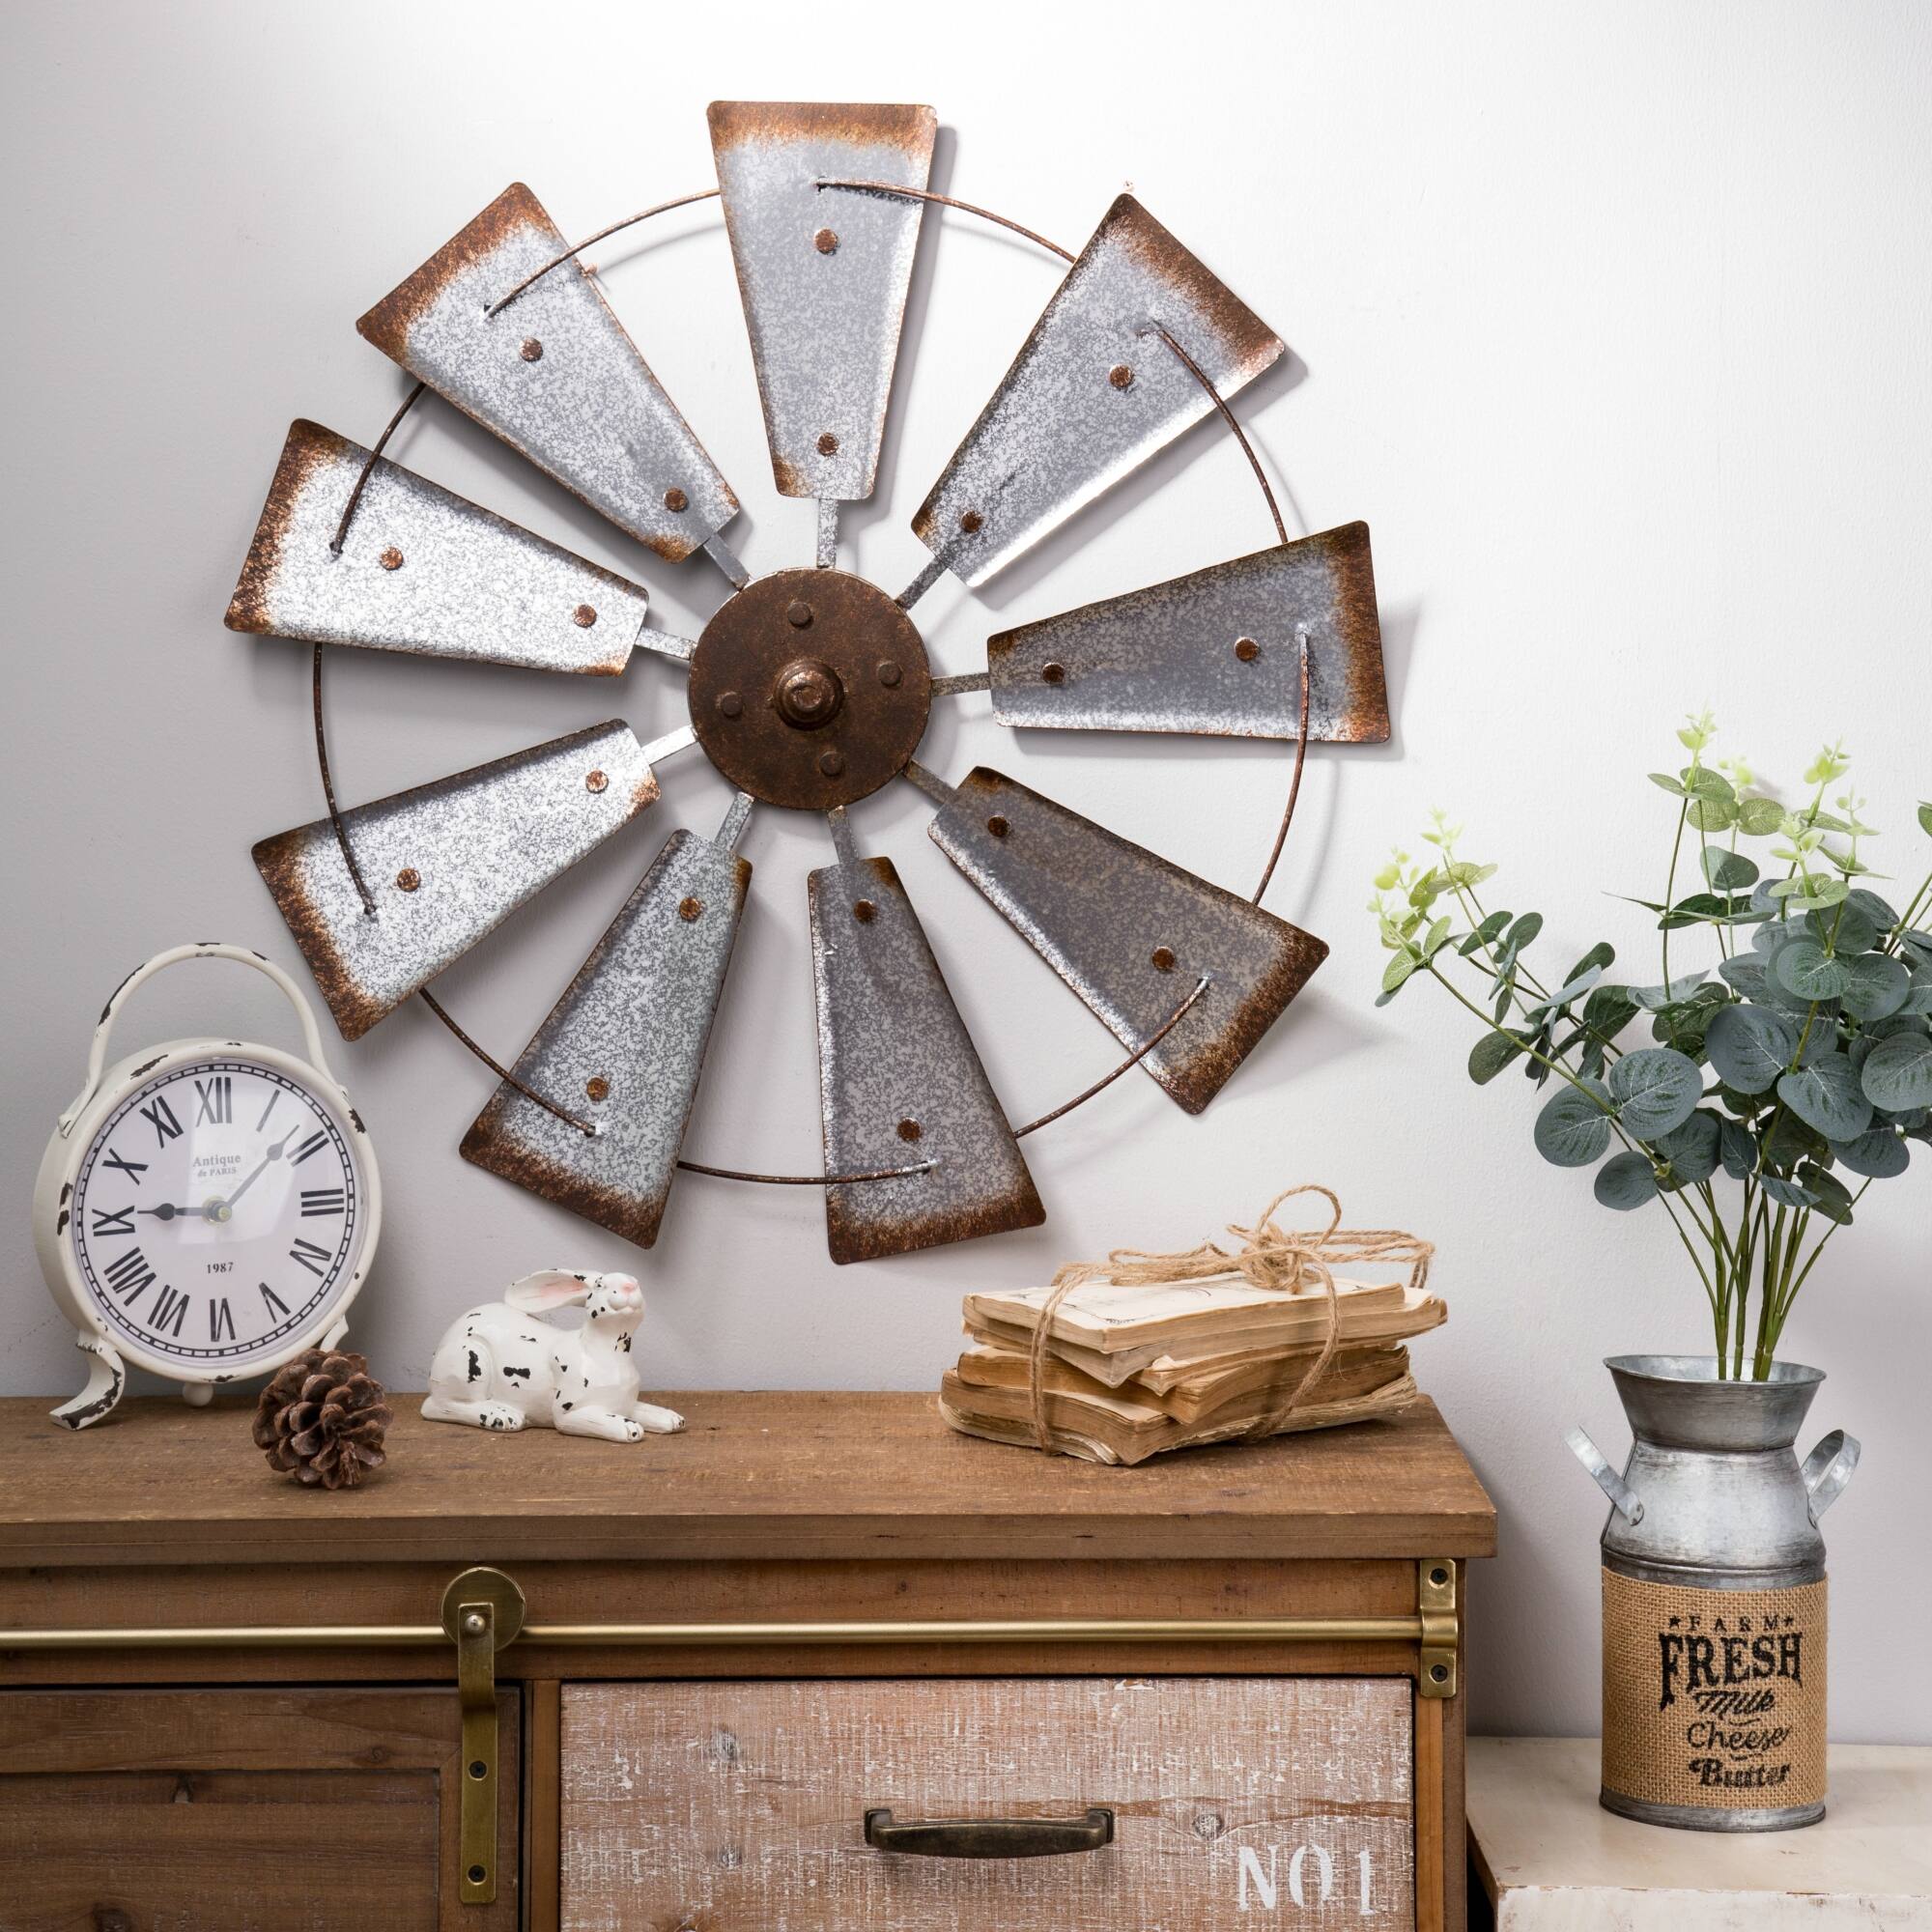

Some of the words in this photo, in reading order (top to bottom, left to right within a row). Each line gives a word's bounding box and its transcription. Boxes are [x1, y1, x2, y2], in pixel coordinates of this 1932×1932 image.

[194, 1076, 232, 1126] XII
[139, 1095, 184, 1149] XI
[101, 1148, 149, 1185] X
[192, 1153, 242, 1168] Antique
[287, 1129, 329, 1167] II
[210, 1167, 237, 1178] PARIS
[92, 1206, 135, 1236] IX
[300, 1188, 345, 1217] III
[206, 1262, 234, 1274] 1987
[289, 1237, 332, 1277] IV
[103, 1246, 156, 1306] VIII
[147, 1284, 190, 1337] VII
[209, 1297, 237, 1342] VI
[259, 1282, 291, 1323] V
[1689, 1614, 1779, 1633] FARM
[1659, 1631, 1804, 1712] FRESH
[1692, 1689, 1776, 1719] Milk
[1687, 1720, 1792, 1751] Cheese
[1689, 1757, 1791, 1788] Butter
